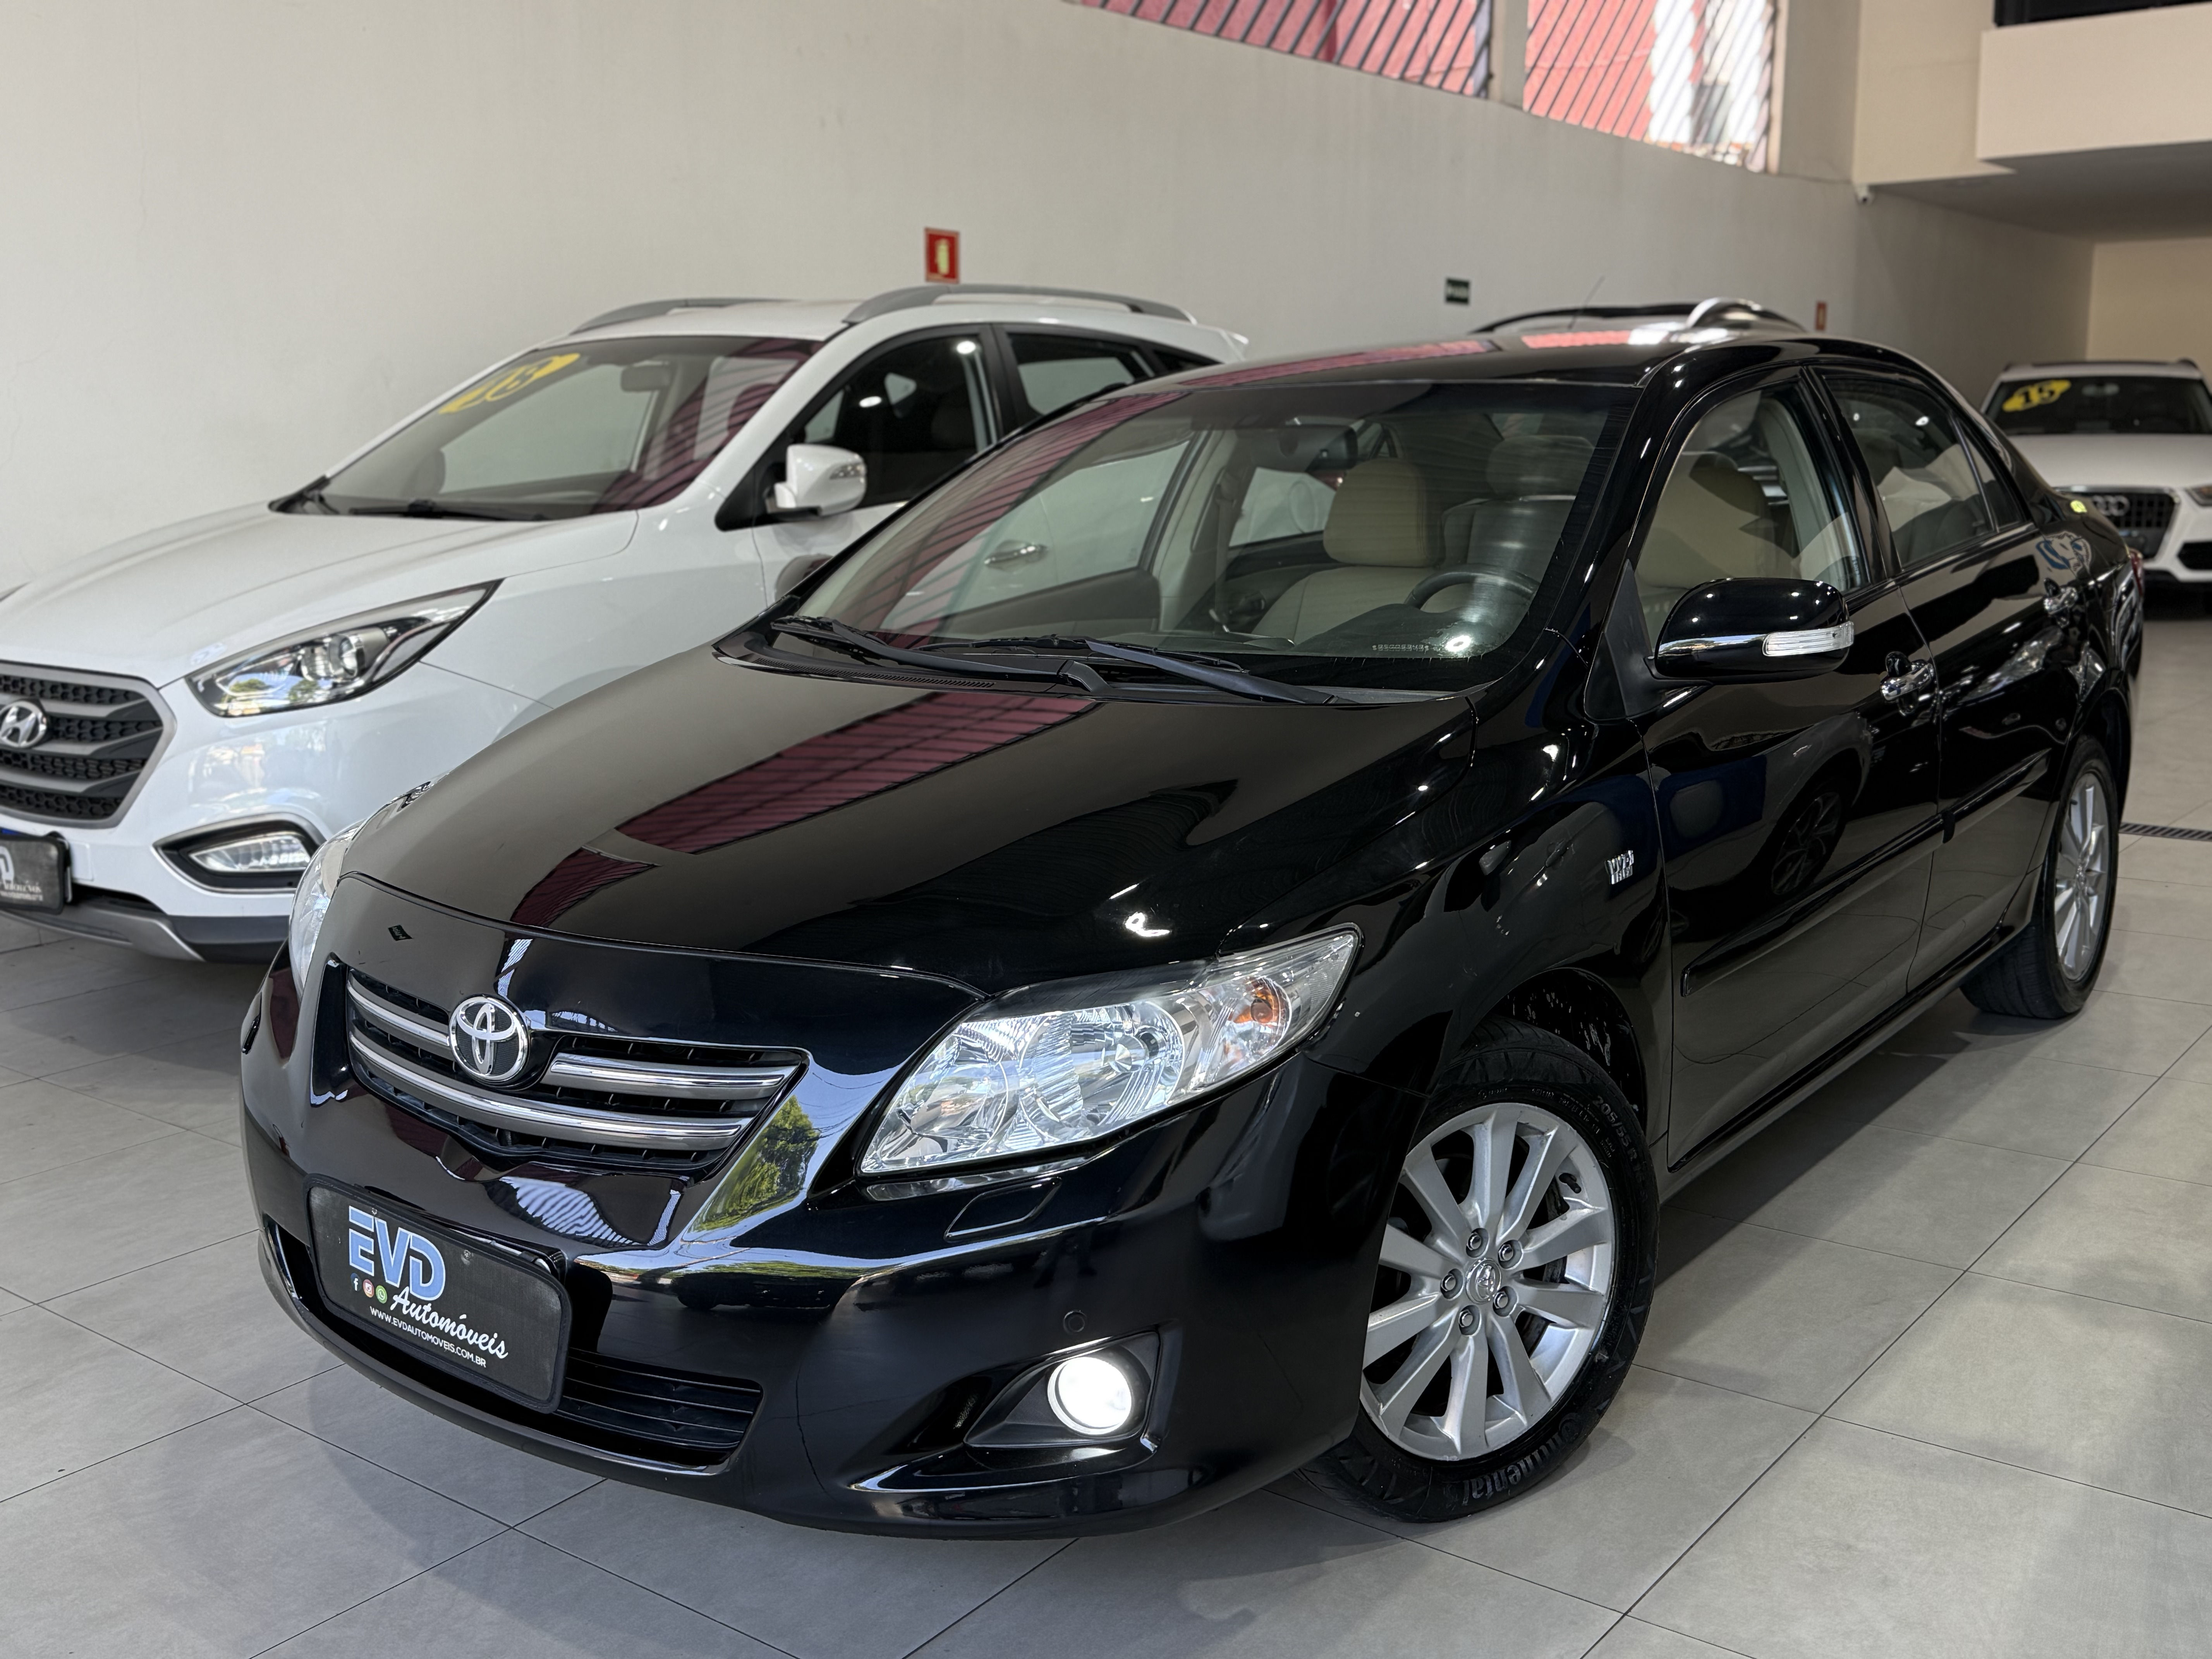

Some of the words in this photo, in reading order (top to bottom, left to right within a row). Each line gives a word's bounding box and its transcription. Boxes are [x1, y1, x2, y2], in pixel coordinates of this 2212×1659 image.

[1592, 1094, 1632, 1148] 205/55
[349, 1205, 446, 1301] EVD
[369, 1306, 486, 1368] WWW.EVDAUTOMOVEIS.COM.BR
[390, 1286, 508, 1359] Automóveis
